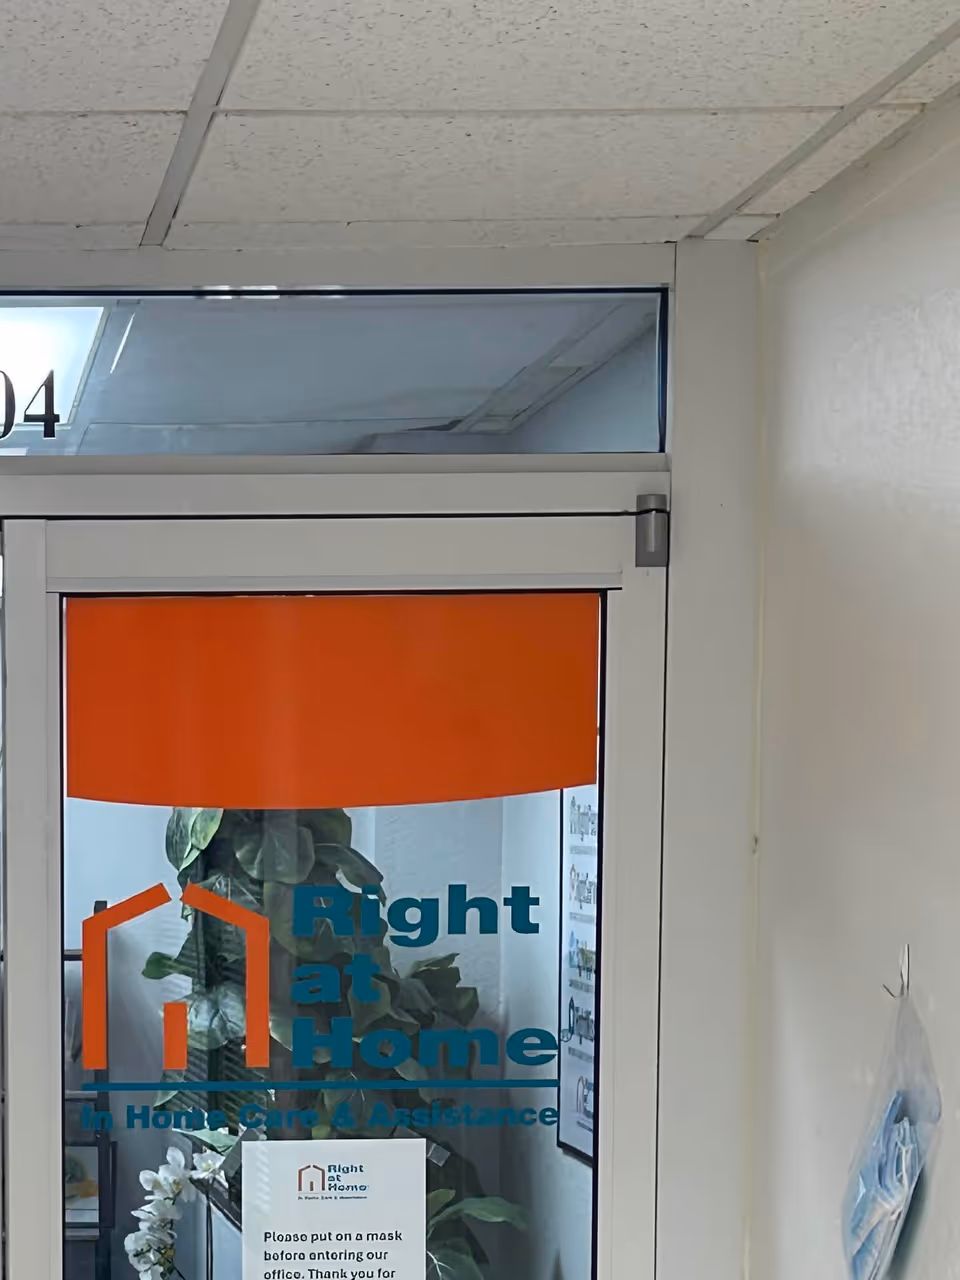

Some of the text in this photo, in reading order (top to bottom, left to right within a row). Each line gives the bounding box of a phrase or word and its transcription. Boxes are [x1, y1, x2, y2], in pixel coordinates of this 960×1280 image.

[292, 884, 540, 948] Right
[292, 954, 381, 1003] at
[292, 1017, 559, 1068] Home
[81, 1104, 113, 1130] In
[126, 1103, 227, 1130] Home
[241, 1103, 319, 1128] Care
[332, 1101, 361, 1127] &
[367, 1101, 559, 1128] Assistance
[328, 1164, 364, 1174] Right
[264, 1231, 308, 1242] Please
[311, 1231, 333, 1243] put
[336, 1233, 352, 1242] on
[366, 1230, 403, 1241] mask
[264, 1249, 388, 1262] before entering our
[264, 1268, 396, 1280] office. Thank you for
